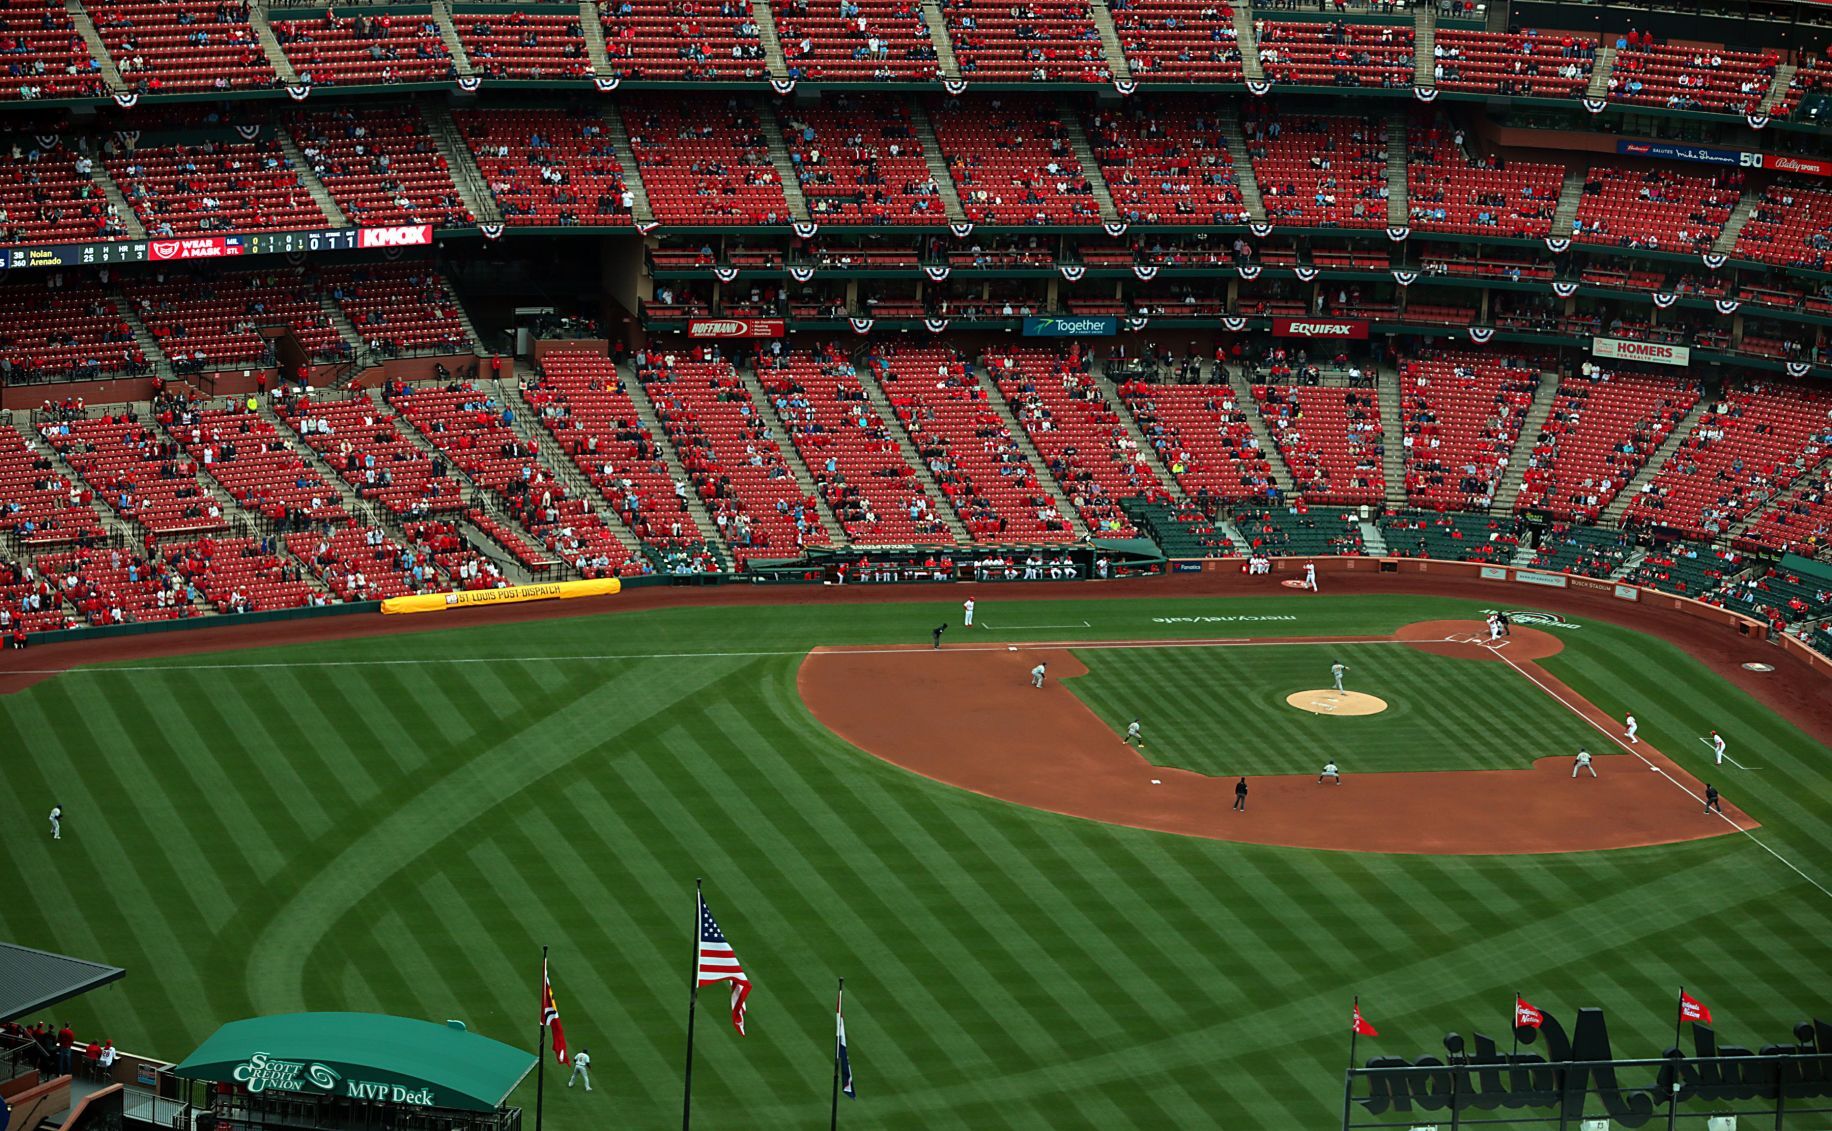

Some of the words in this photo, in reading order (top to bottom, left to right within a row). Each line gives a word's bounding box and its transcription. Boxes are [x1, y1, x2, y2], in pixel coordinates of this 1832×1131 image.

[1740, 152, 1763, 168] 50
[1776, 158, 1800, 172] Bally
[1800, 164, 1820, 172] SPORTS
[252, 237, 258, 245] 0
[269, 236, 274, 244] 1
[286, 235, 292, 243] 0
[364, 226, 426, 247] KMOX
[181, 240, 213, 248] WEAR
[286, 244, 292, 252] 0
[310, 239, 318, 250] 0
[328, 238, 336, 248] 1
[347, 237, 352, 248] 1
[30, 250, 52, 258] Nolan
[181, 249, 190, 257] A
[191, 247, 221, 257] MASK
[30, 258, 62, 266] Arenado
[692, 322, 739, 333] HOFFMANN
[1056, 320, 1106, 334] Together
[1290, 322, 1351, 336] EQUIFAX
[1618, 342, 1672, 358] HOMERS
[1588, 582, 1612, 591] STADIUM
[460, 594, 469, 602] ST
[472, 592, 496, 602] LOUIS
[1152, 615, 1297, 624] mercy.net/safe
[348, 1082, 388, 1100] MVP
[393, 1087, 432, 1106] Deck
